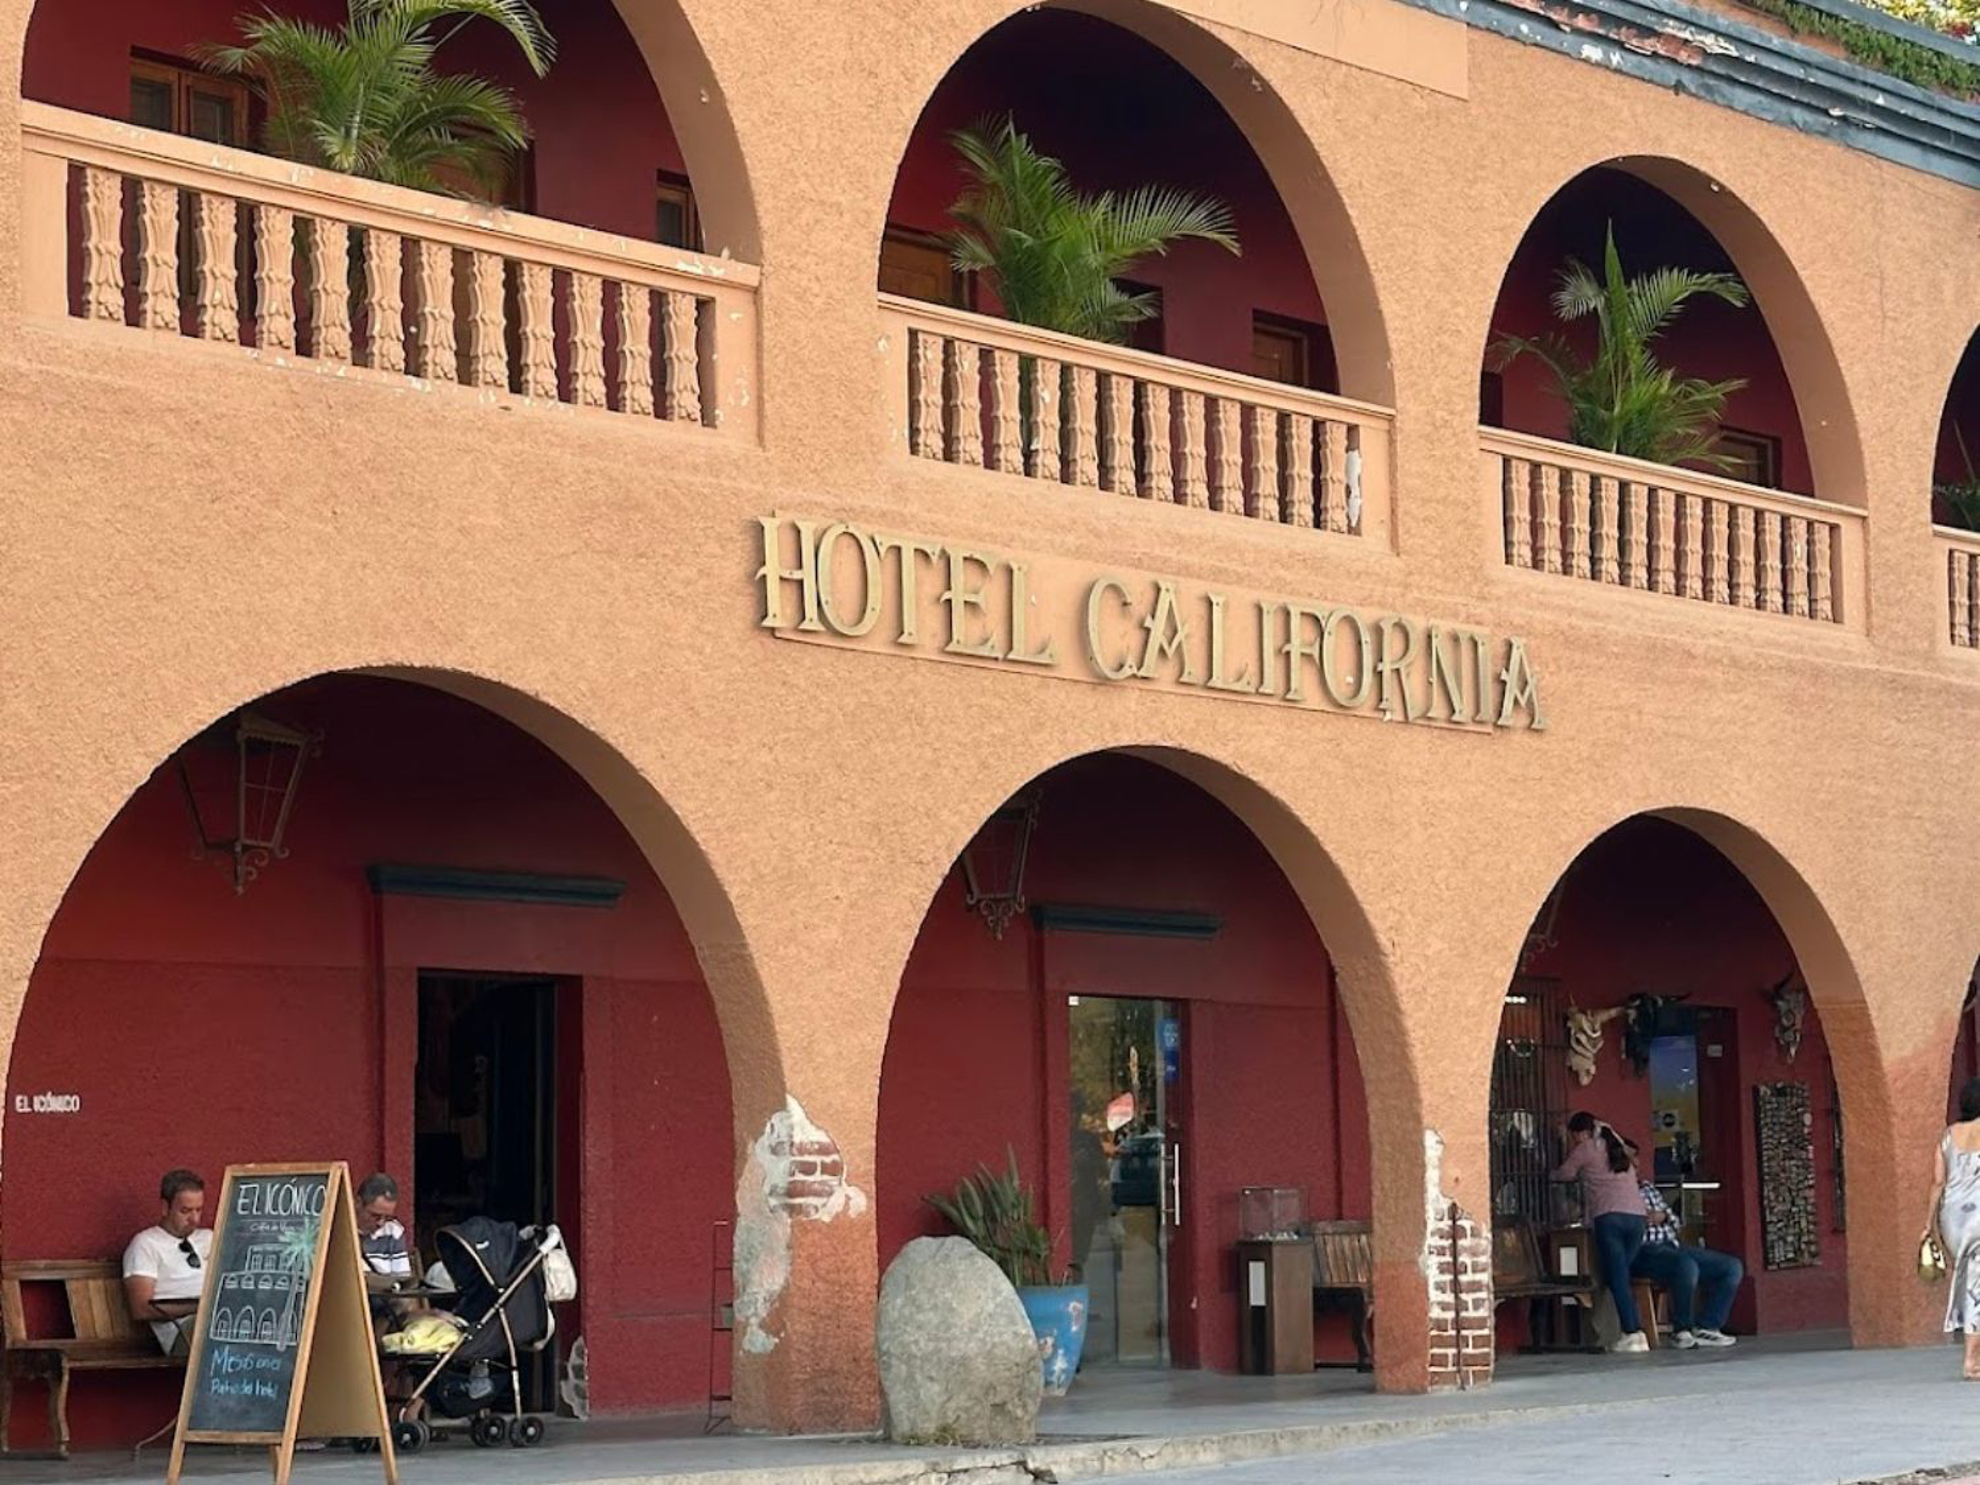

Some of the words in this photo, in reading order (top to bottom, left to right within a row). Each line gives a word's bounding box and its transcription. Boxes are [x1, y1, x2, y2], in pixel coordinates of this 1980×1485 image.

[755, 515, 1056, 666] HOTEL
[1087, 578, 1546, 729] CALIFORNIA
[15, 1095, 32, 1112] EL
[237, 1184, 262, 1215] EL
